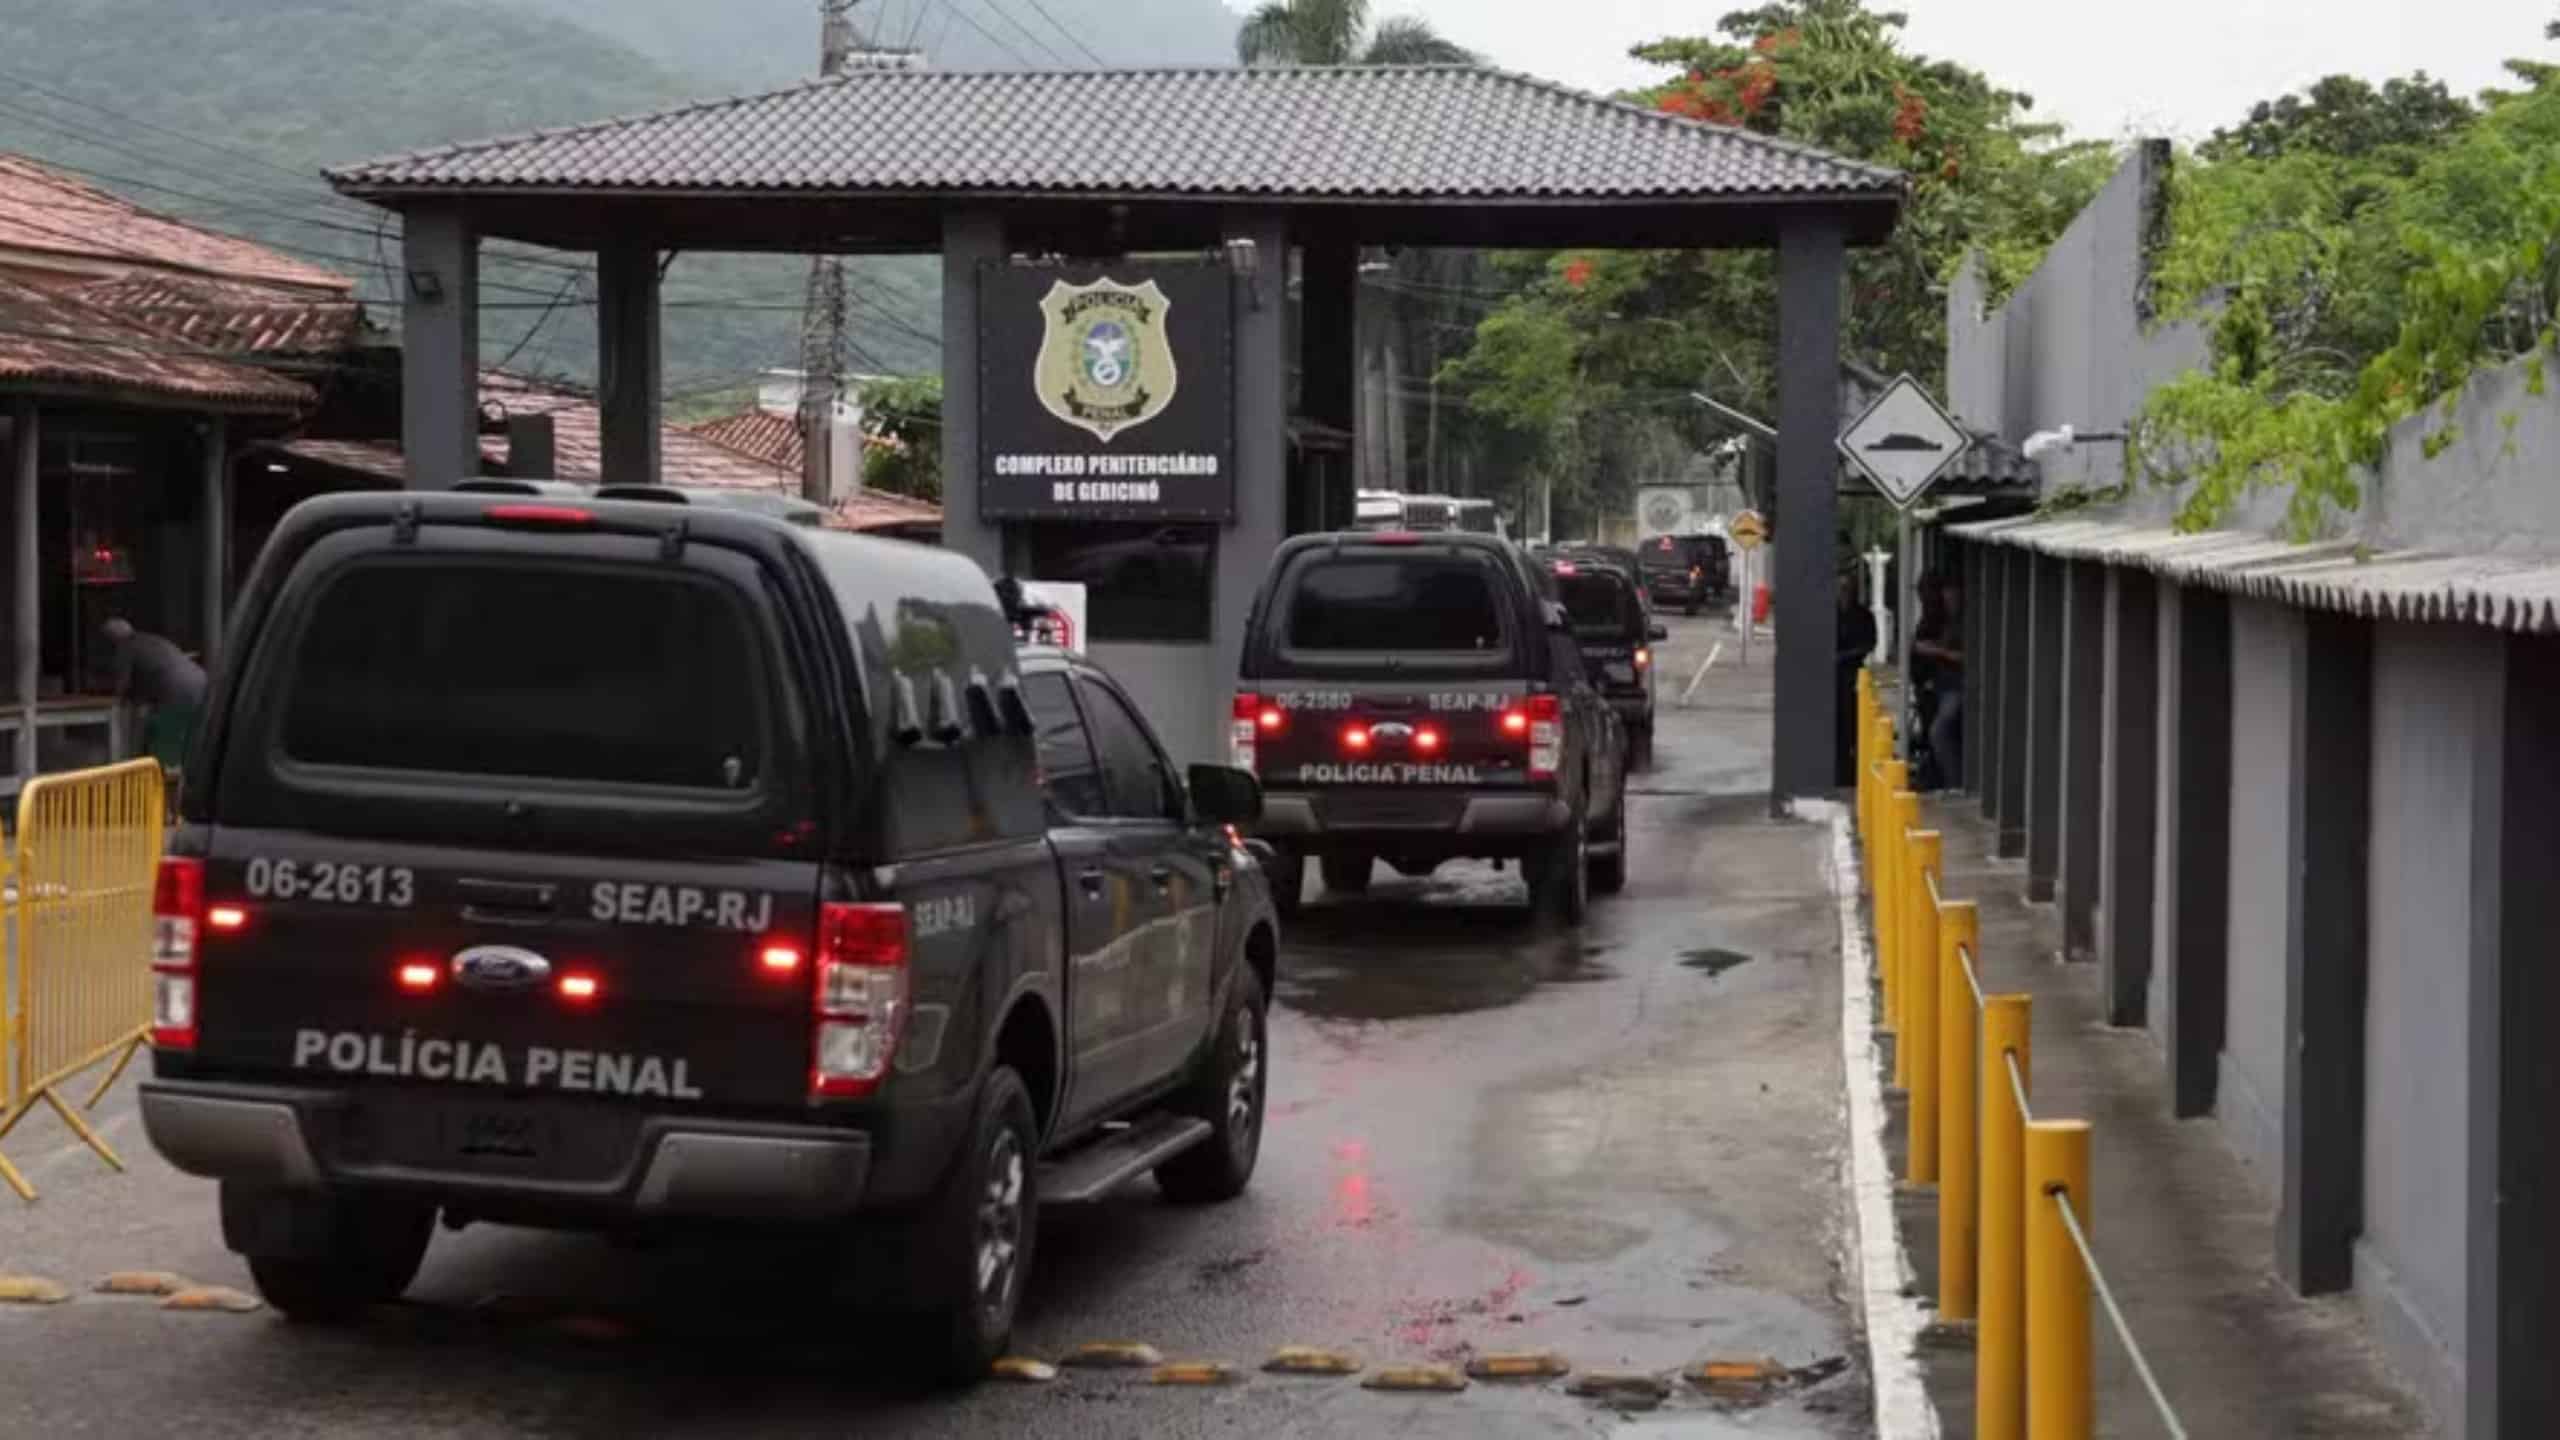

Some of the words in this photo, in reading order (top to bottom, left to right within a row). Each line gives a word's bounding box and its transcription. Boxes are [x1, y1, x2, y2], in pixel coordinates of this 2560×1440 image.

[995, 454, 1085, 475] COMPLEXO
[1088, 451, 1218, 475] PENITENCIÁRIO
[1053, 482, 1075, 501] DE
[1078, 479, 1160, 502] GERICINÓ
[1429, 693, 1509, 711] SEAP-RJ
[1402, 764, 1481, 784] PENAL
[248, 857, 414, 905] 06-2613
[591, 881, 772, 932] SEAP-RJ
[293, 1027, 508, 1083] POLÍCIA
[525, 1046, 701, 1098] PENAL
